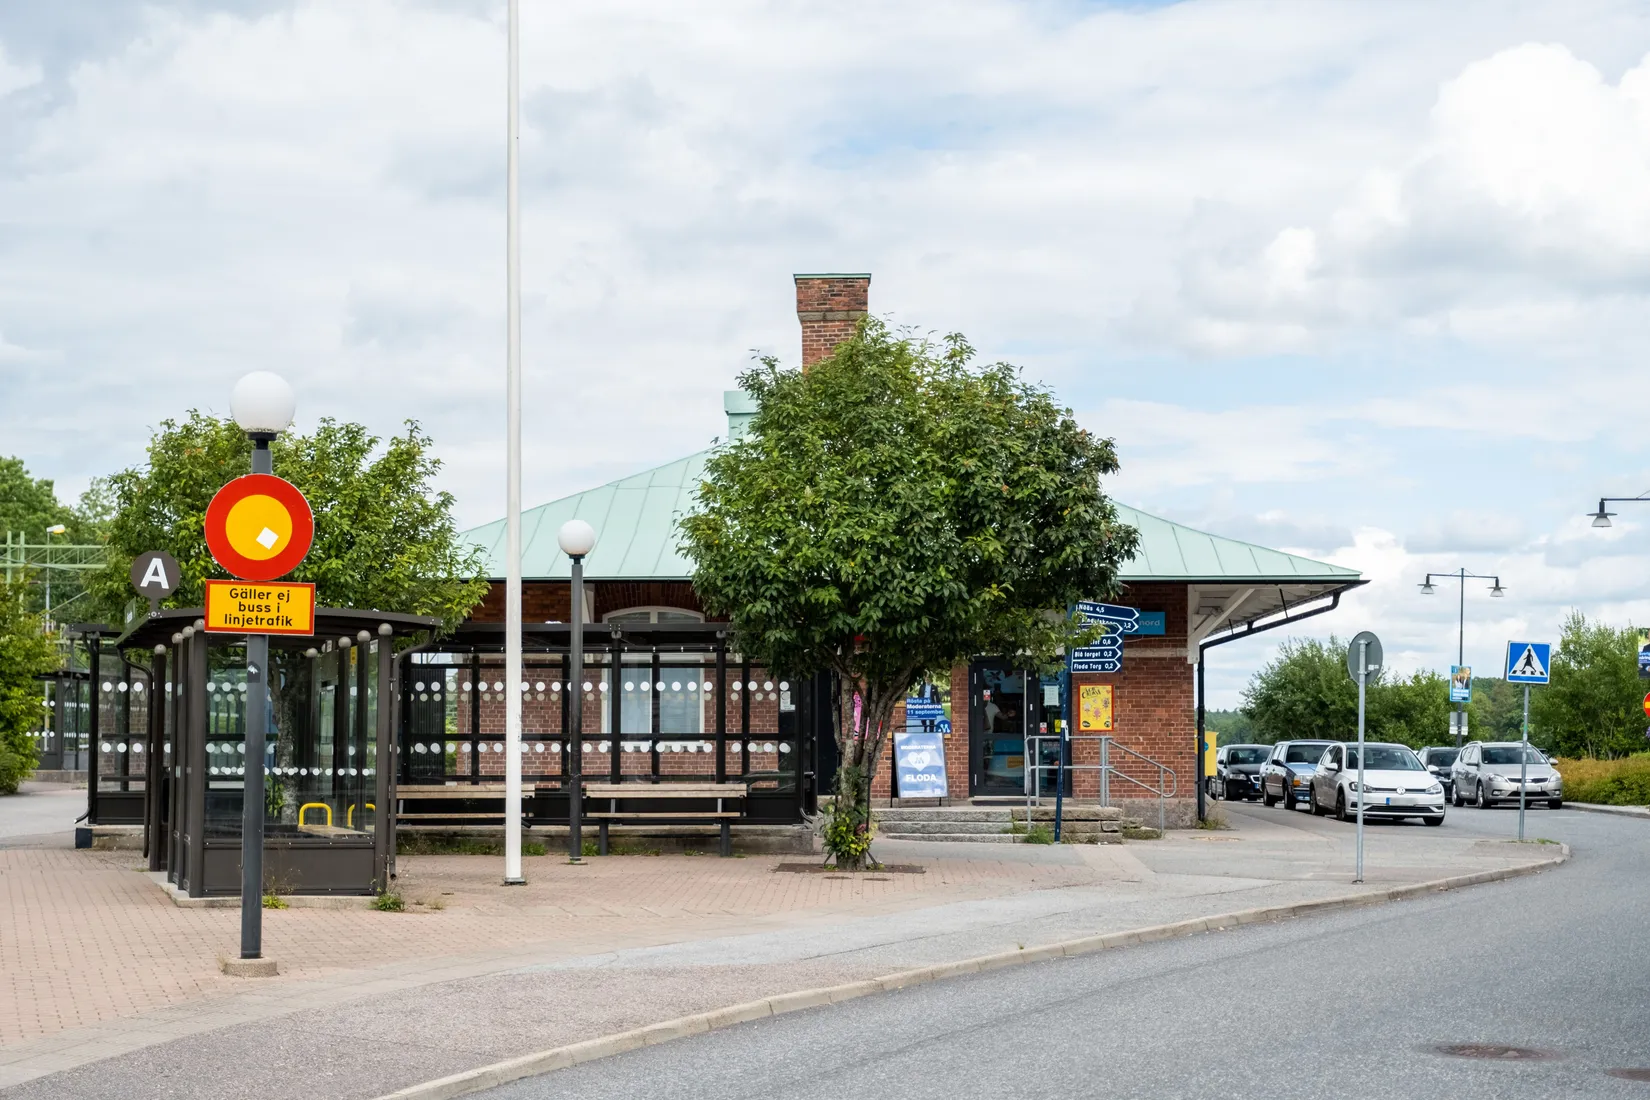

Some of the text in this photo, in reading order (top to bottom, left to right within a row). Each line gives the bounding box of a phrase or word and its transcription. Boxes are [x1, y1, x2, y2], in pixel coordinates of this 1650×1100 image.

[140, 557, 170, 590] A
[229, 588, 291, 604] Gäller ej
[238, 601, 281, 614] buss i
[224, 613, 293, 628] linjetrafik
[1103, 650, 1113, 658] 0,2
[1089, 663, 1102, 671] Torg
[1104, 662, 1114, 670] 0,2
[905, 773, 937, 782] FLODA
